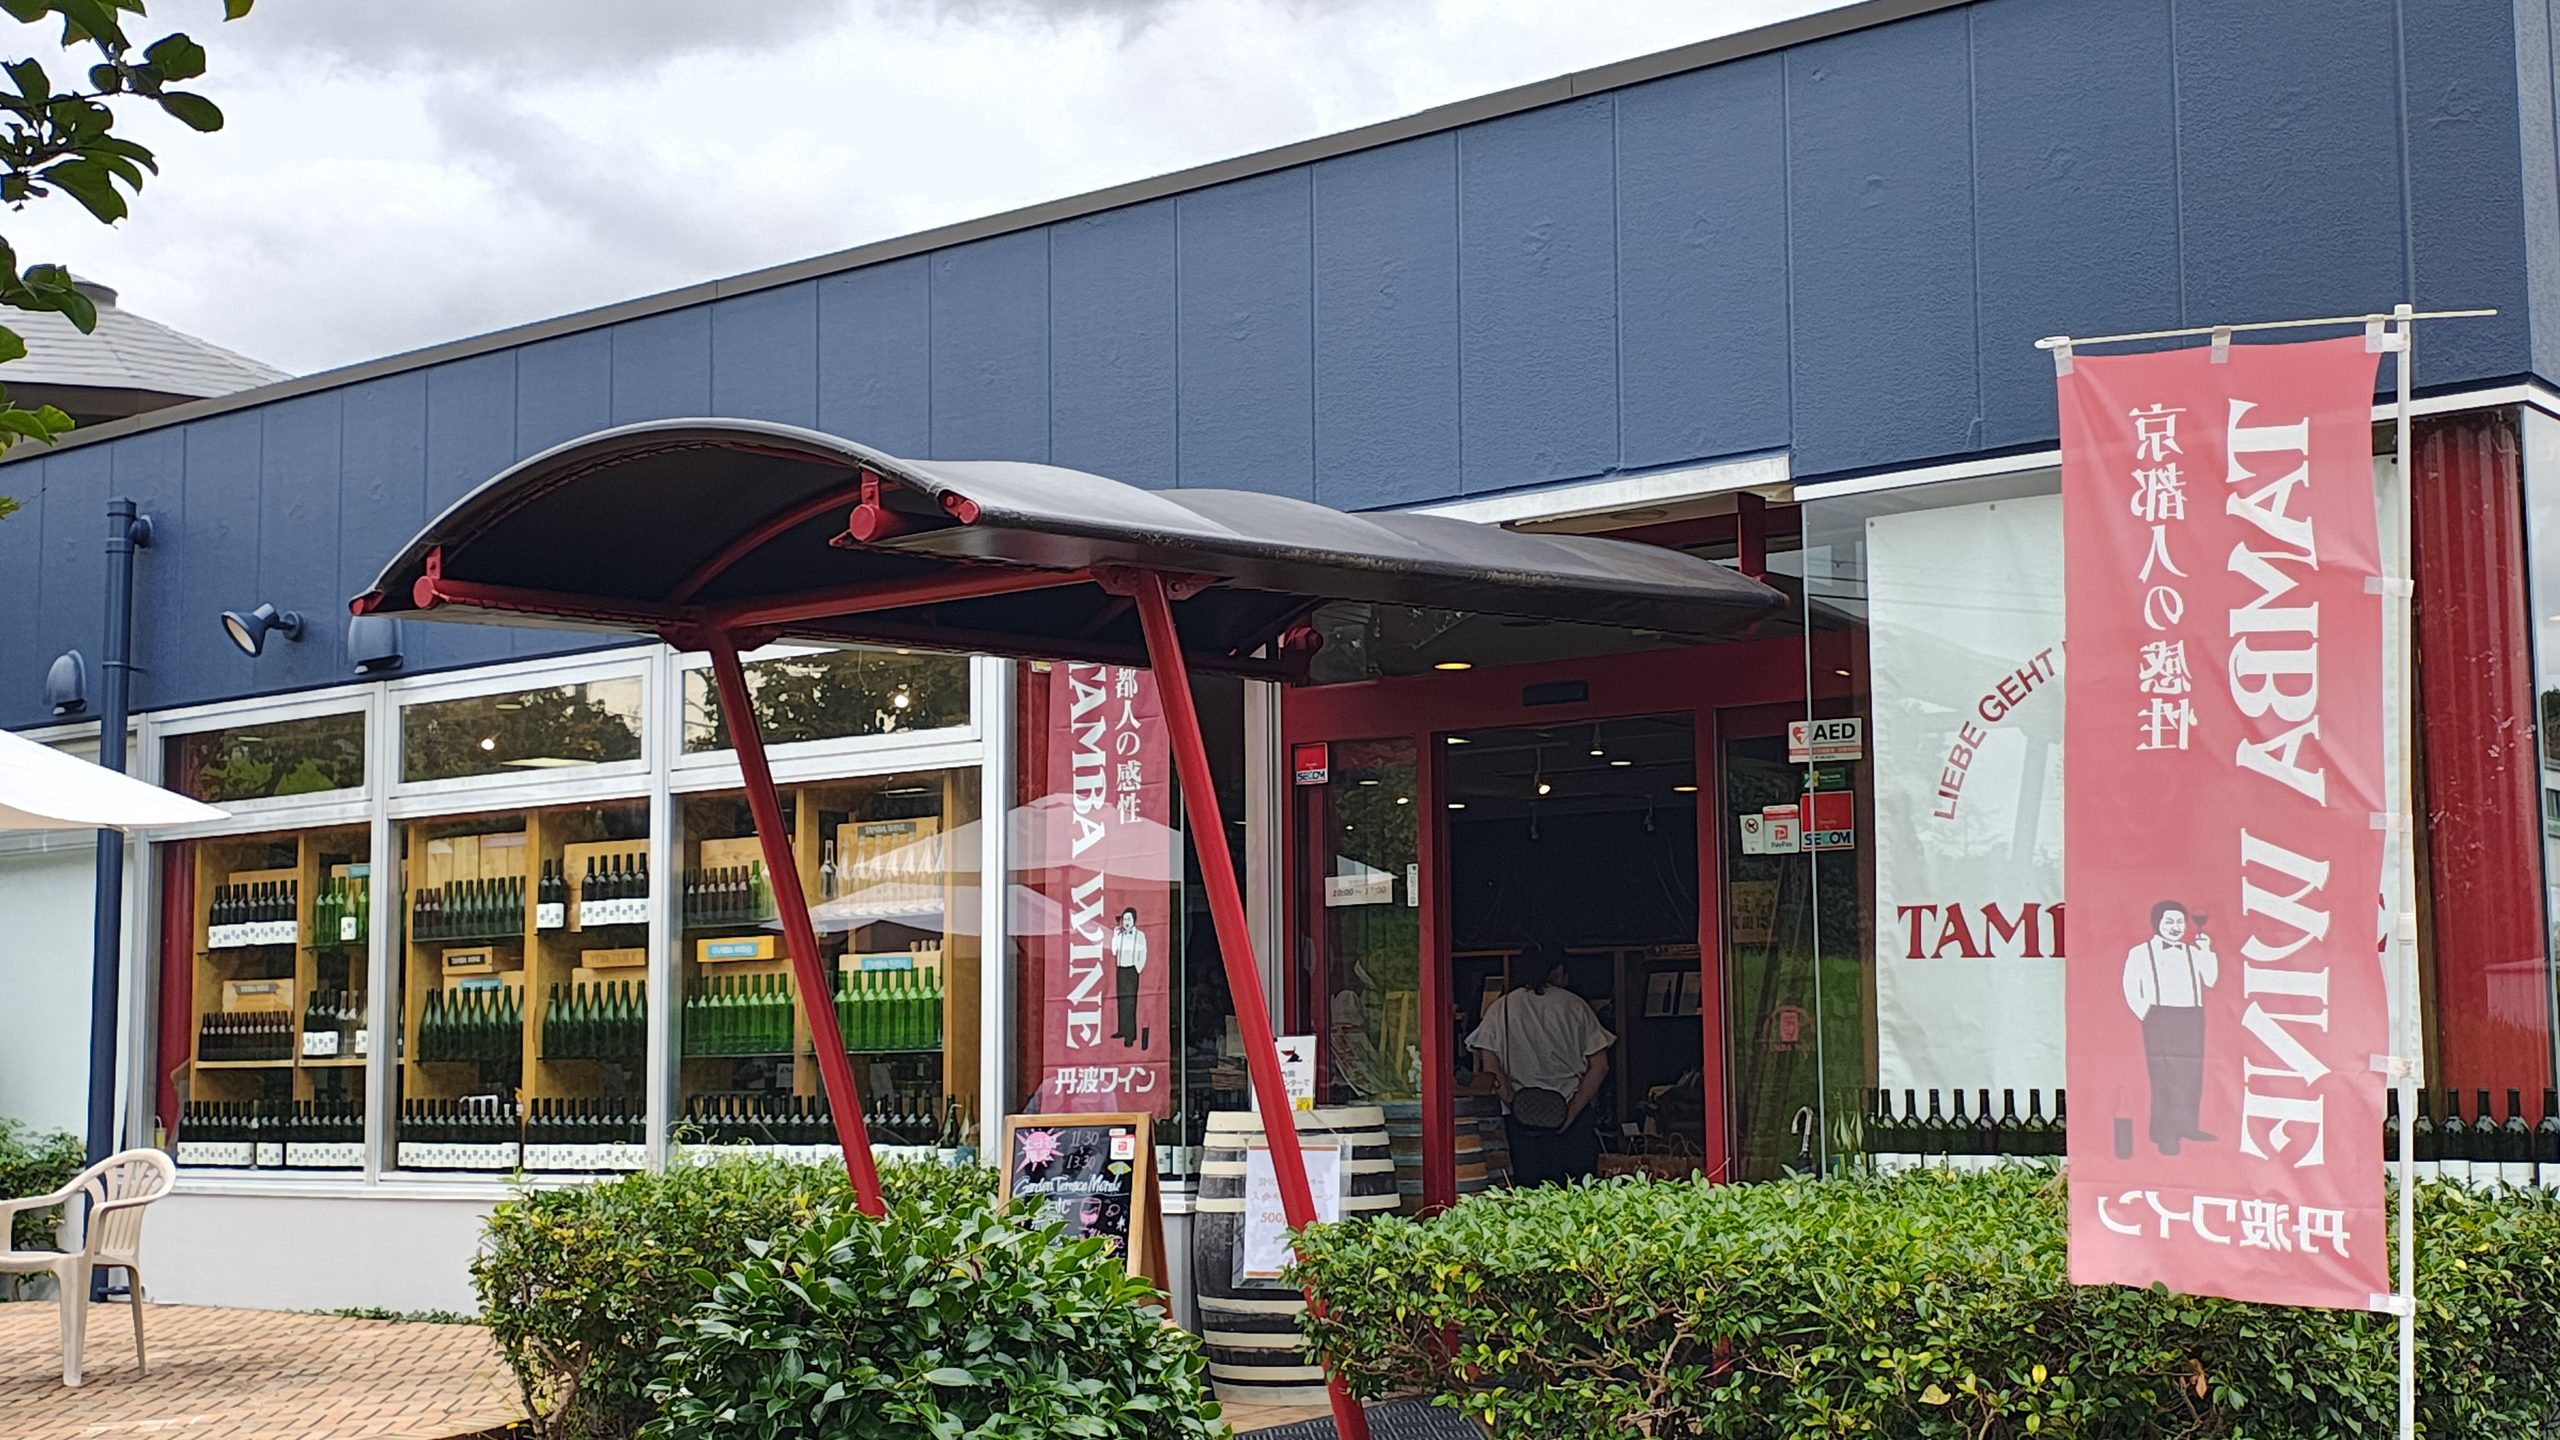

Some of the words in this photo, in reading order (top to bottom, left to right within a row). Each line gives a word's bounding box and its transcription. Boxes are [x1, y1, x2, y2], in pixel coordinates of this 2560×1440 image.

[1813, 723, 1856, 741] AED
[1933, 720, 1988, 820] LIEBE
[1978, 647, 2056, 722] GEHT
[1066, 870, 1105, 1049] WINE
[1054, 1066, 1156, 1096] 丹波ワイン
